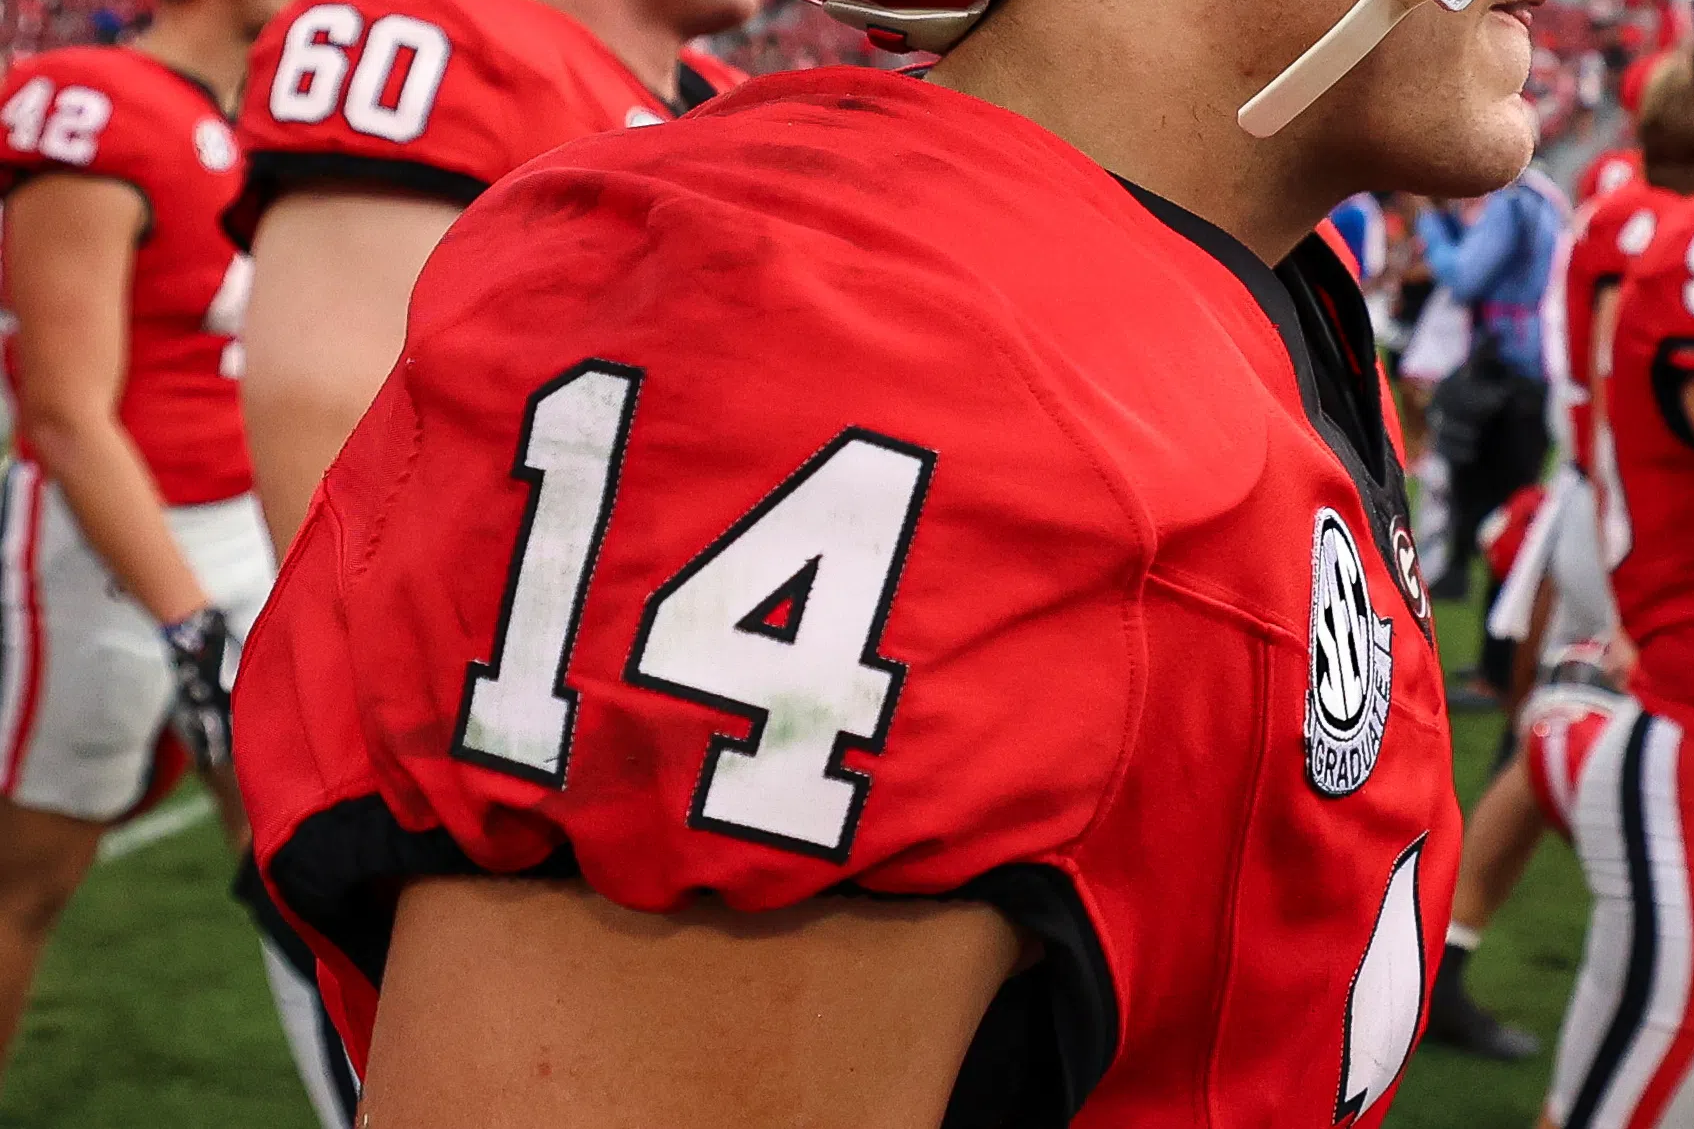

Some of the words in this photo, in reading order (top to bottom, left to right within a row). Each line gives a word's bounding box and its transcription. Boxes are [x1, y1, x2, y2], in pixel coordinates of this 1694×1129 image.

[0, 74, 114, 167] 42
[269, 2, 451, 144] 60
[450, 356, 938, 865] 14
[1313, 673, 1391, 790] GRADUATE
